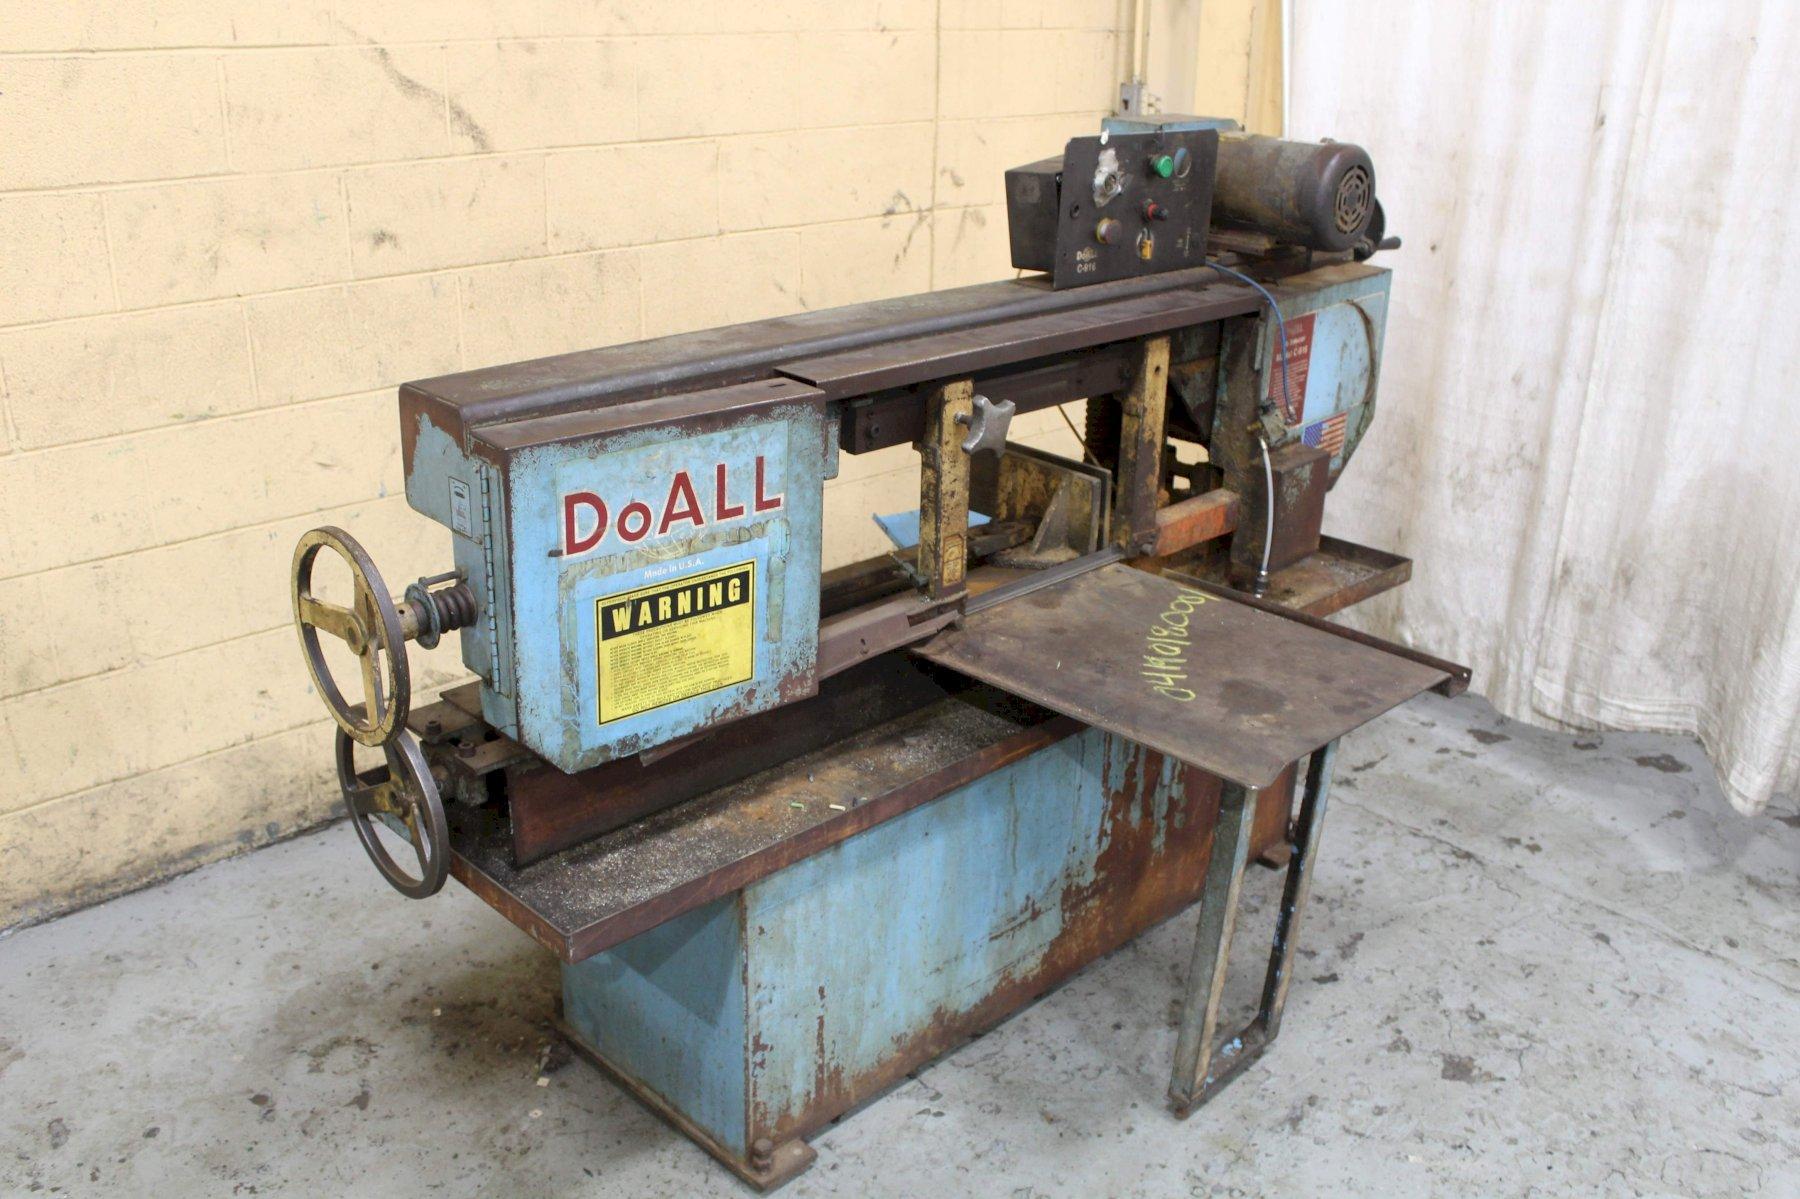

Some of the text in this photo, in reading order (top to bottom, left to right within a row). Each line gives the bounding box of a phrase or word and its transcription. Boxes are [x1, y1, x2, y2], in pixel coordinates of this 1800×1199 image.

[563, 455, 783, 557] DoALL
[644, 567, 668, 580] Made
[679, 557, 705, 570] U.S.A.
[612, 577, 741, 633] WARNING
